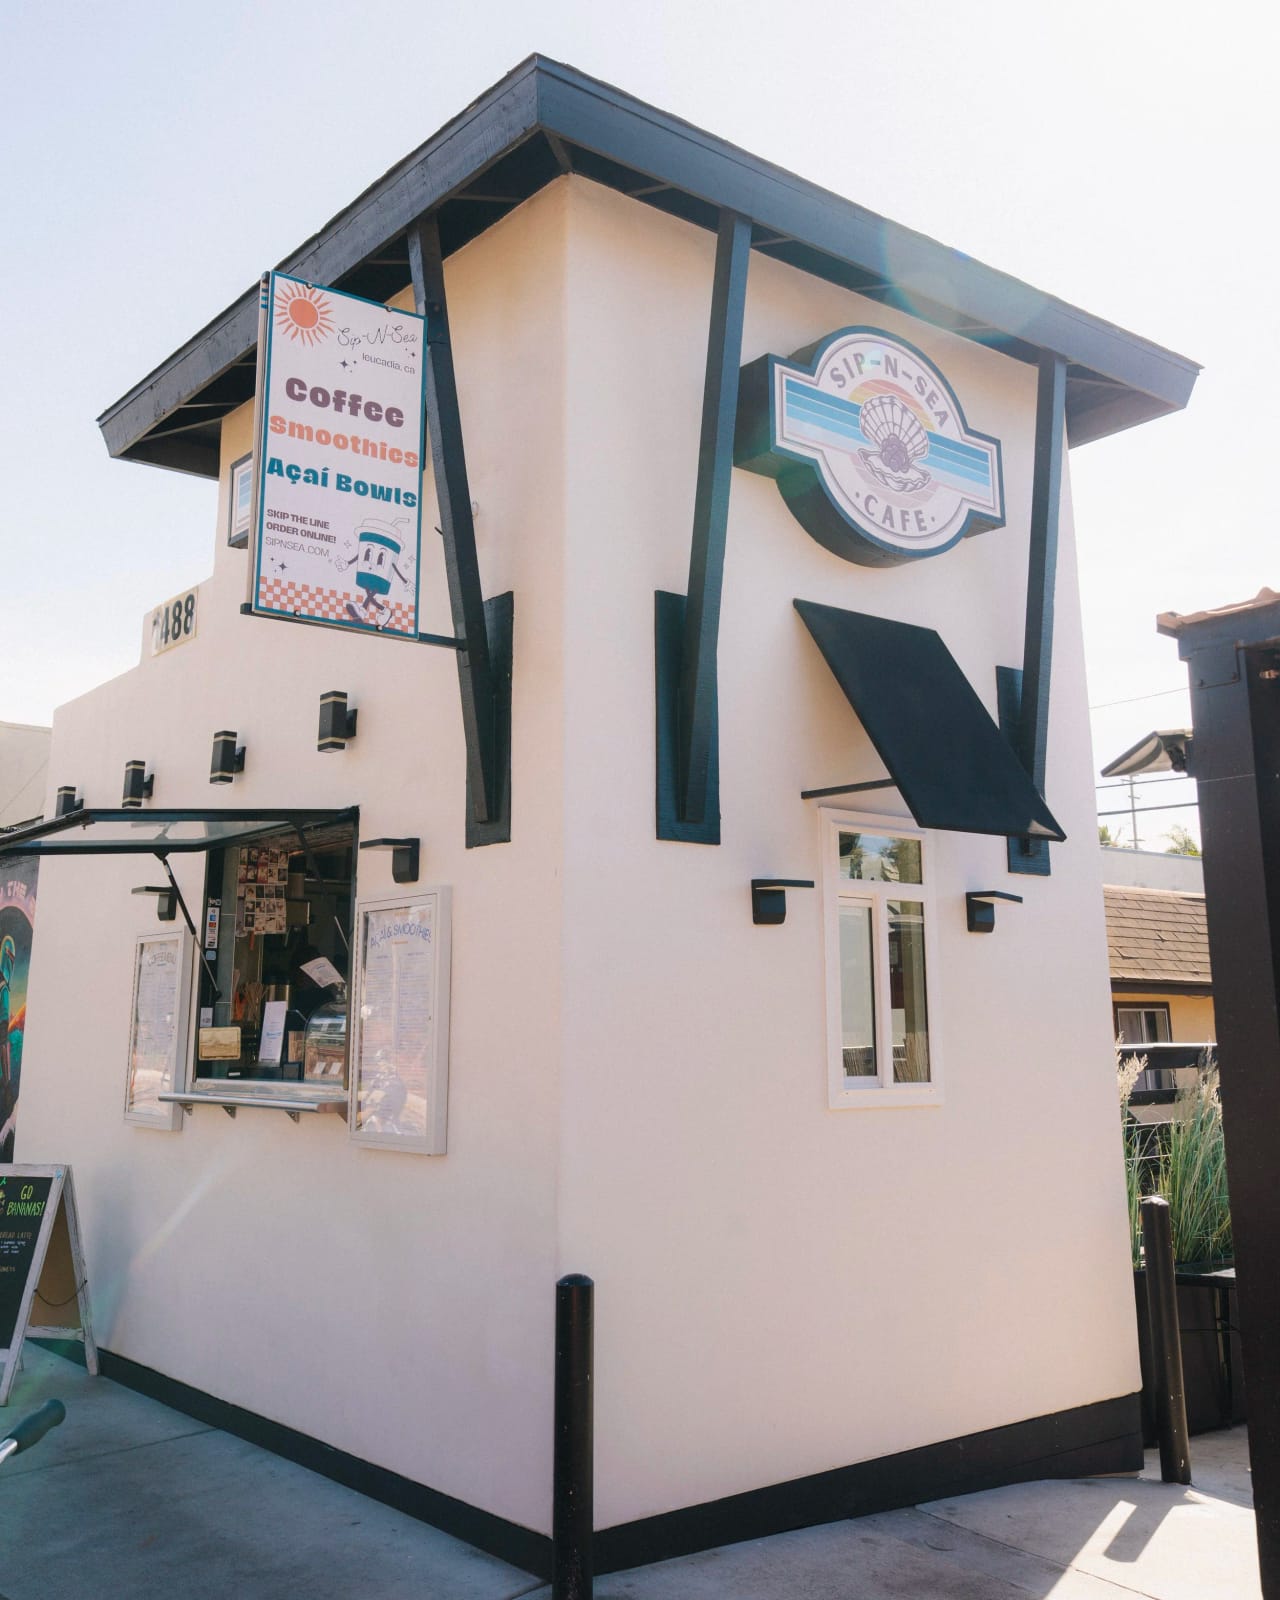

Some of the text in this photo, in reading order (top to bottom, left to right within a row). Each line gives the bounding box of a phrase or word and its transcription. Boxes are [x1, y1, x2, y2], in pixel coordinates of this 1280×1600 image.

[830, 351, 949, 427] SIP-N-SEA
[285, 377, 405, 428] Coffee
[266, 457, 417, 508] Açaí Bowls
[266, 508, 330, 530] SKIP THE LINE
[266, 521, 337, 544] ORDER ONLINE!
[265, 536, 330, 558] SIPNSEA.COM
[20, 1184, 34, 1200] GO
[6, 1201, 46, 1217] BANANAS!
